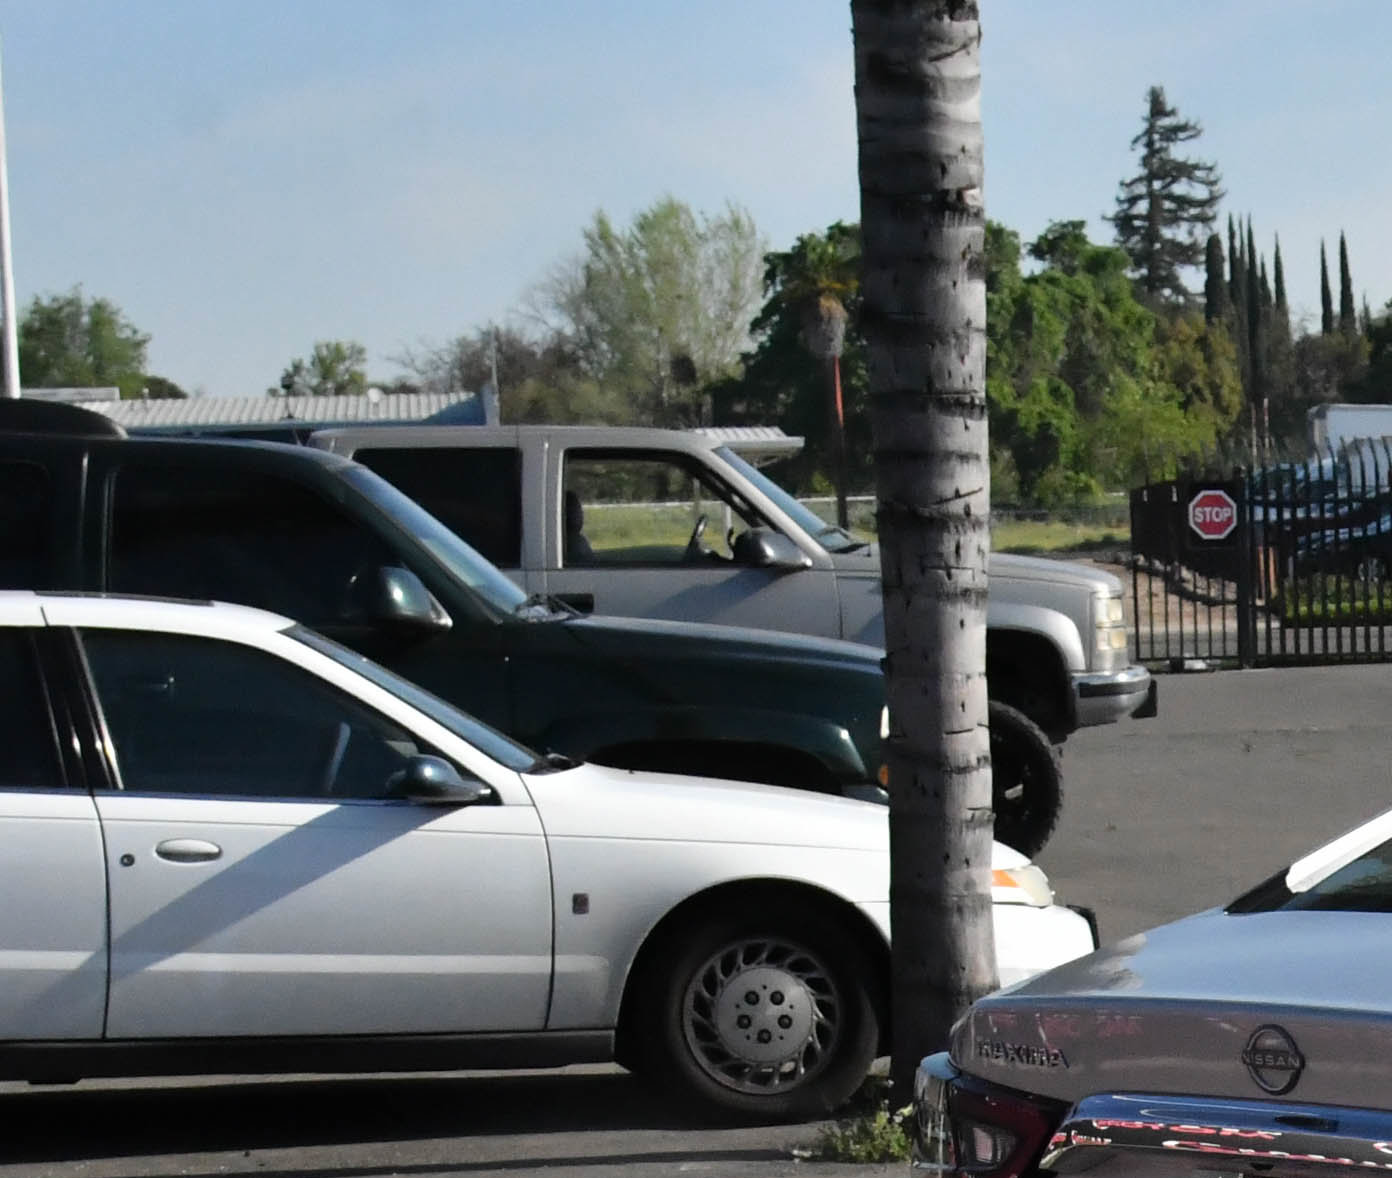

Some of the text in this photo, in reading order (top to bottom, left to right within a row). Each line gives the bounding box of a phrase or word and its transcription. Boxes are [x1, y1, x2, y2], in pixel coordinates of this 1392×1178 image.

[1194, 507, 1232, 523] STOP
[977, 1040, 1070, 1069] MAXIMA
[1242, 1053, 1300, 1068] NISSAN
